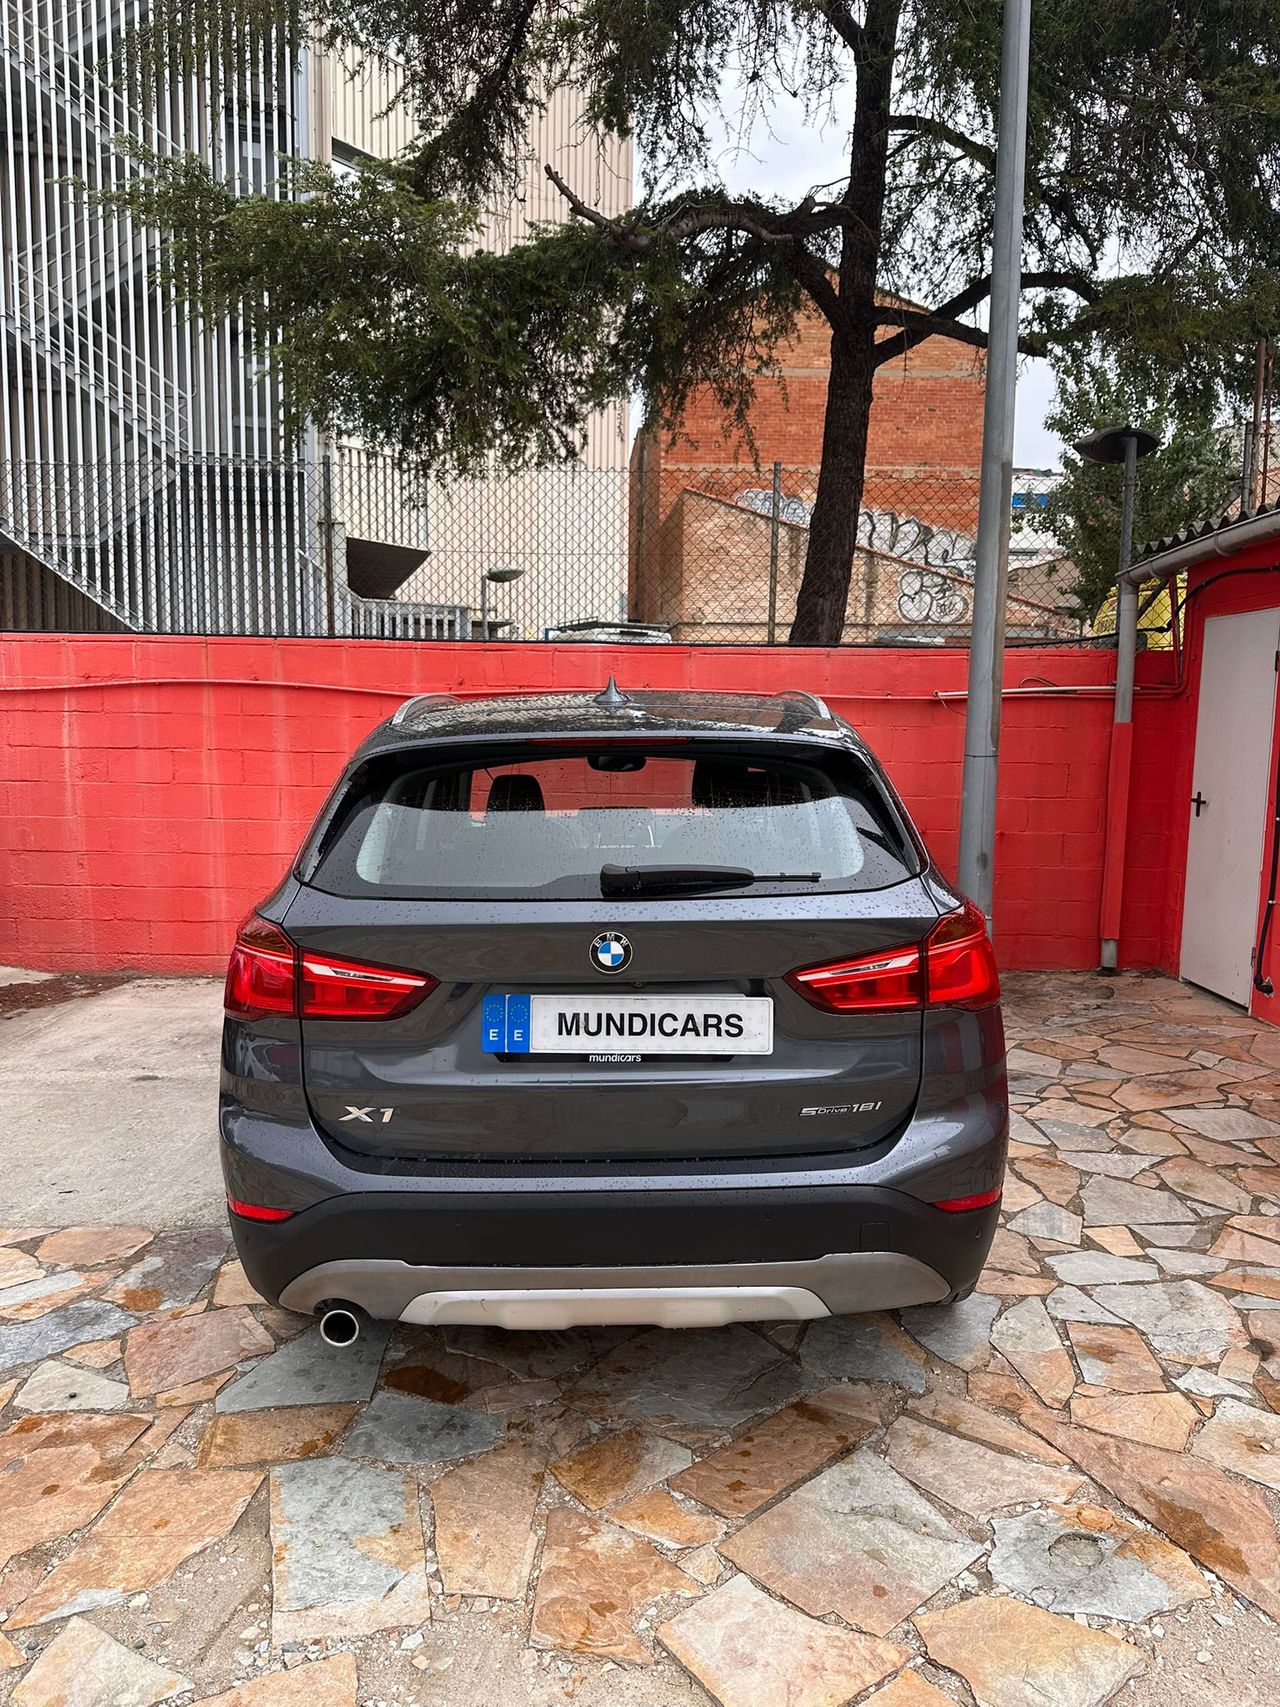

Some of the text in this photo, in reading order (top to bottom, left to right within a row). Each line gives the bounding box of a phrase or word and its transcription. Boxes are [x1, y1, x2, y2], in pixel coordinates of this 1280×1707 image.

[594, 933, 629, 947] BMW
[557, 1012, 744, 1038] MUNDICARS
[489, 1029, 499, 1041] E
[513, 1029, 524, 1041] E
[589, 1053, 642, 1062] mundicars
[338, 1105, 394, 1122] X1
